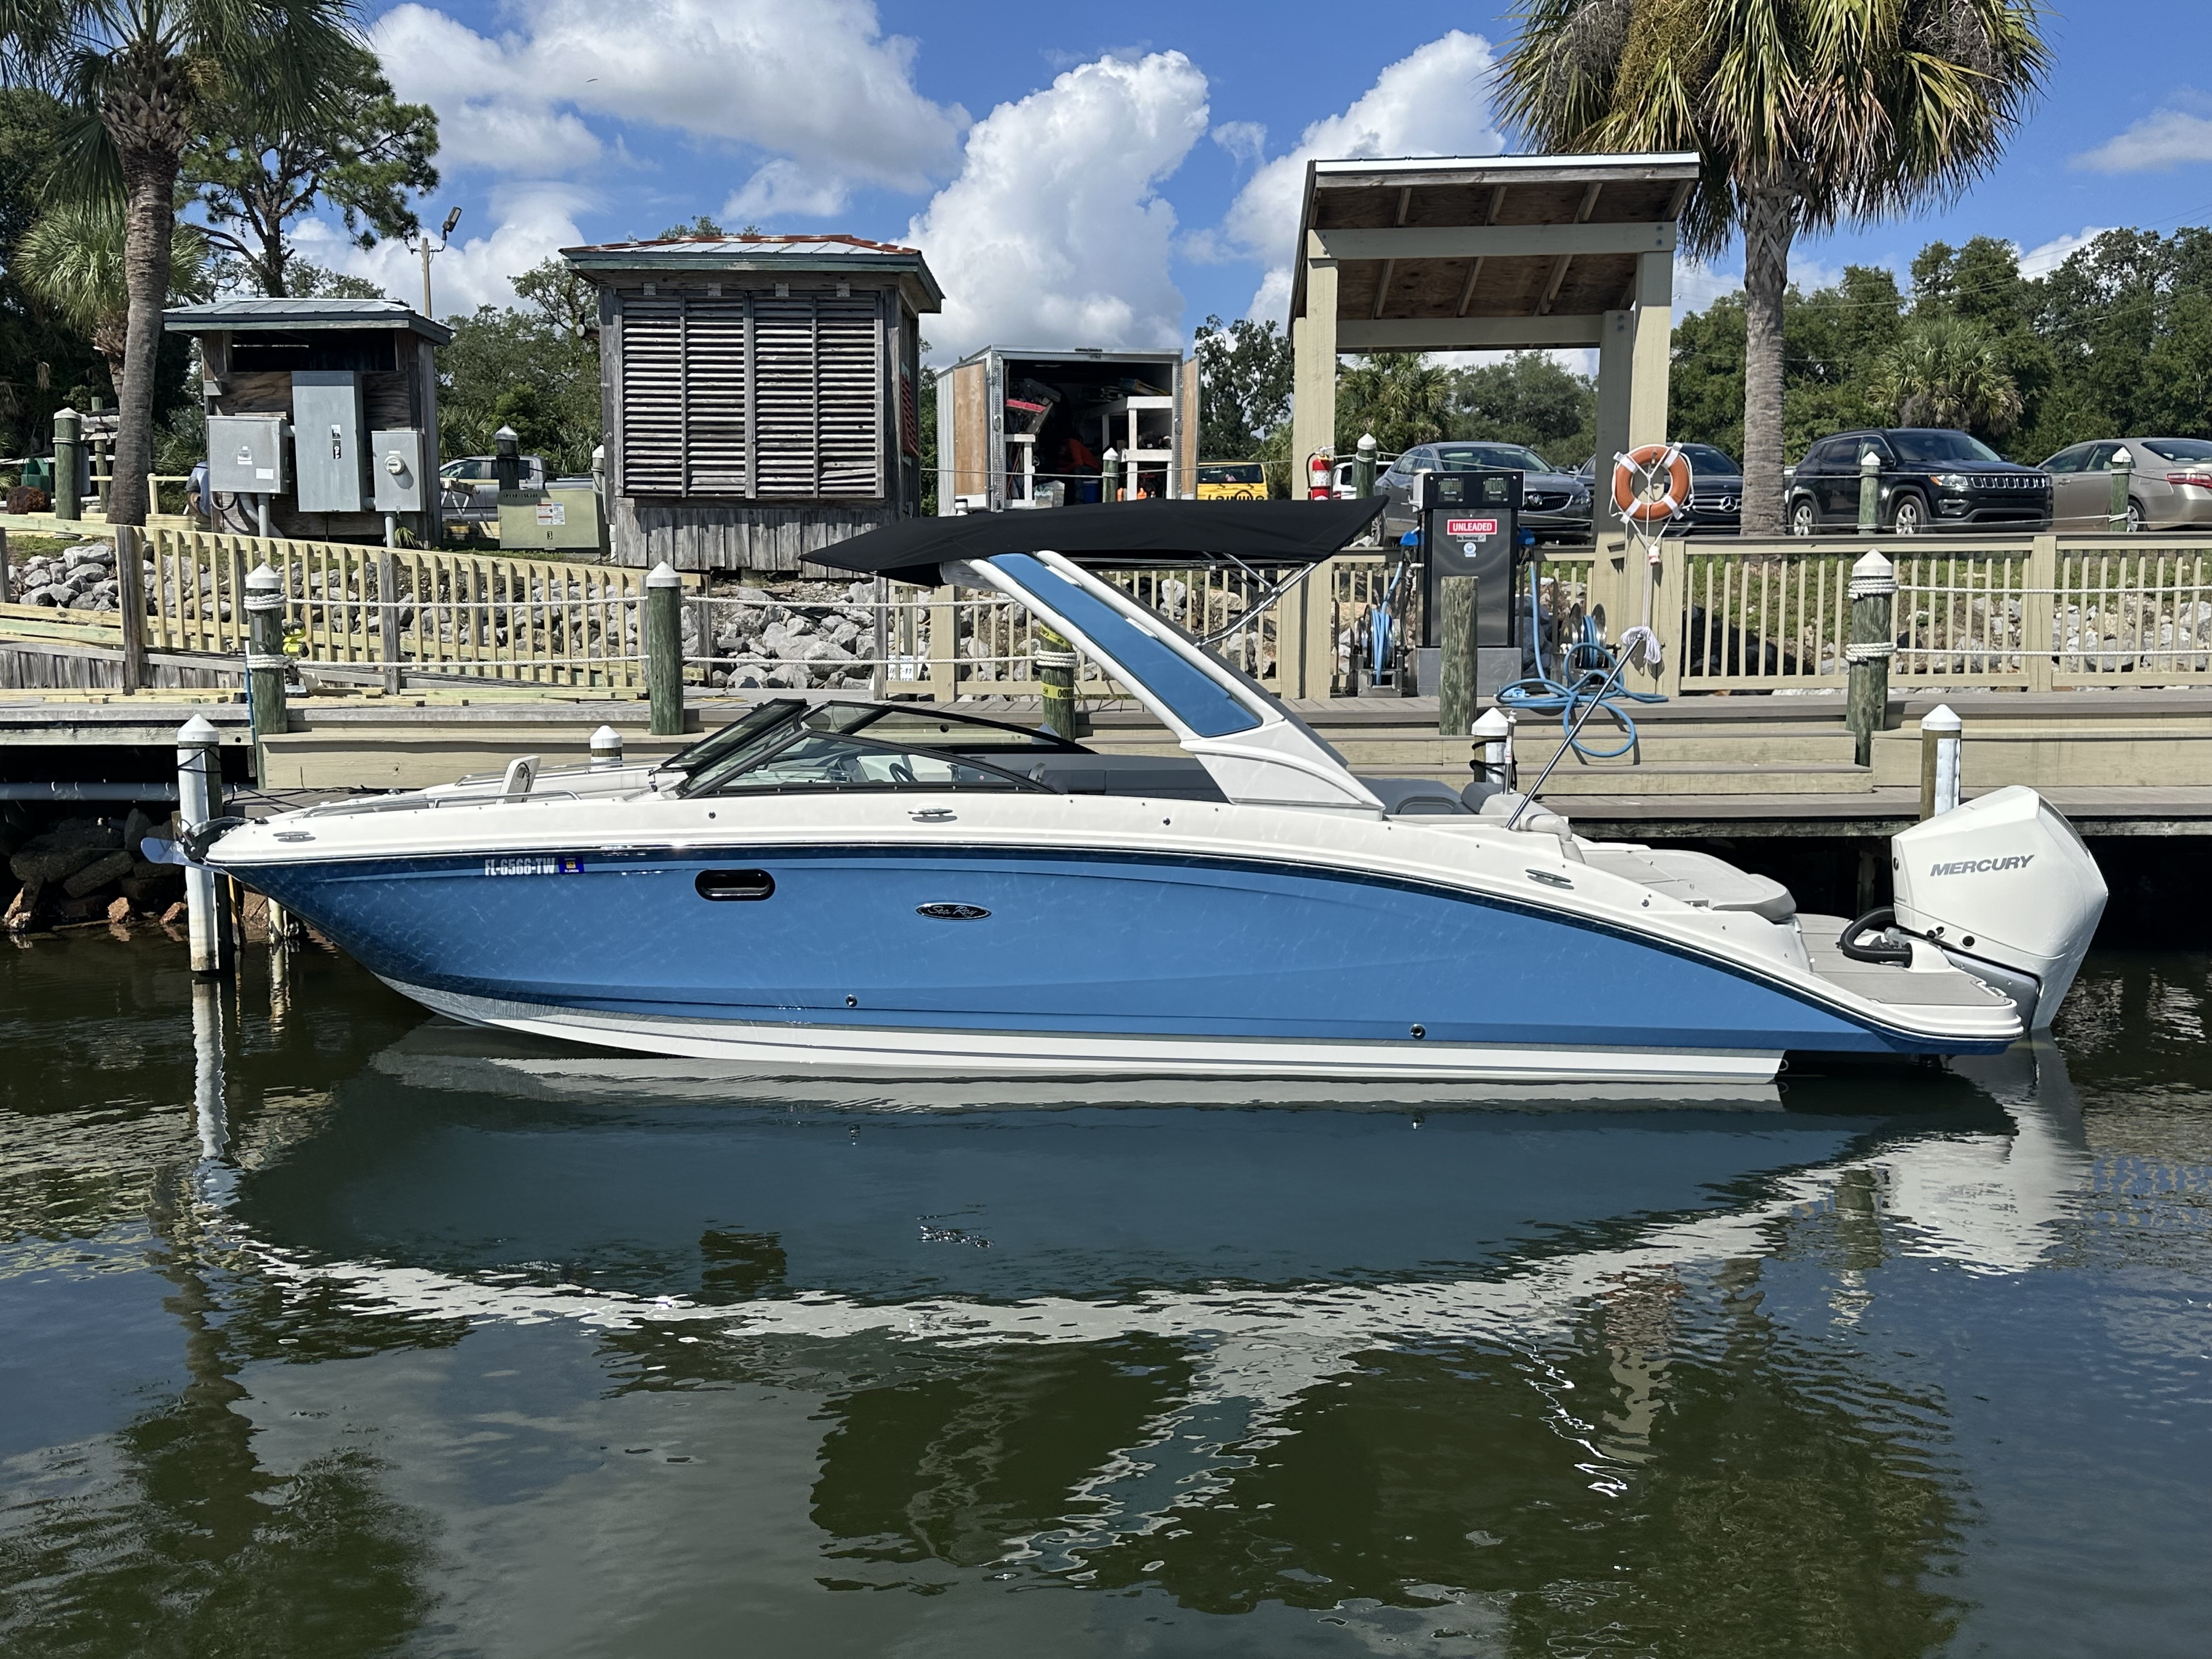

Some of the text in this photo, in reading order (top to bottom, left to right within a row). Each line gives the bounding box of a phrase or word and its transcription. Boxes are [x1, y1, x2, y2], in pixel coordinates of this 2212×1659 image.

[1453, 522, 1492, 532] UNLEADED
[1930, 854, 2035, 876] MERCURY
[928, 906, 978, 917] Sea Ray
